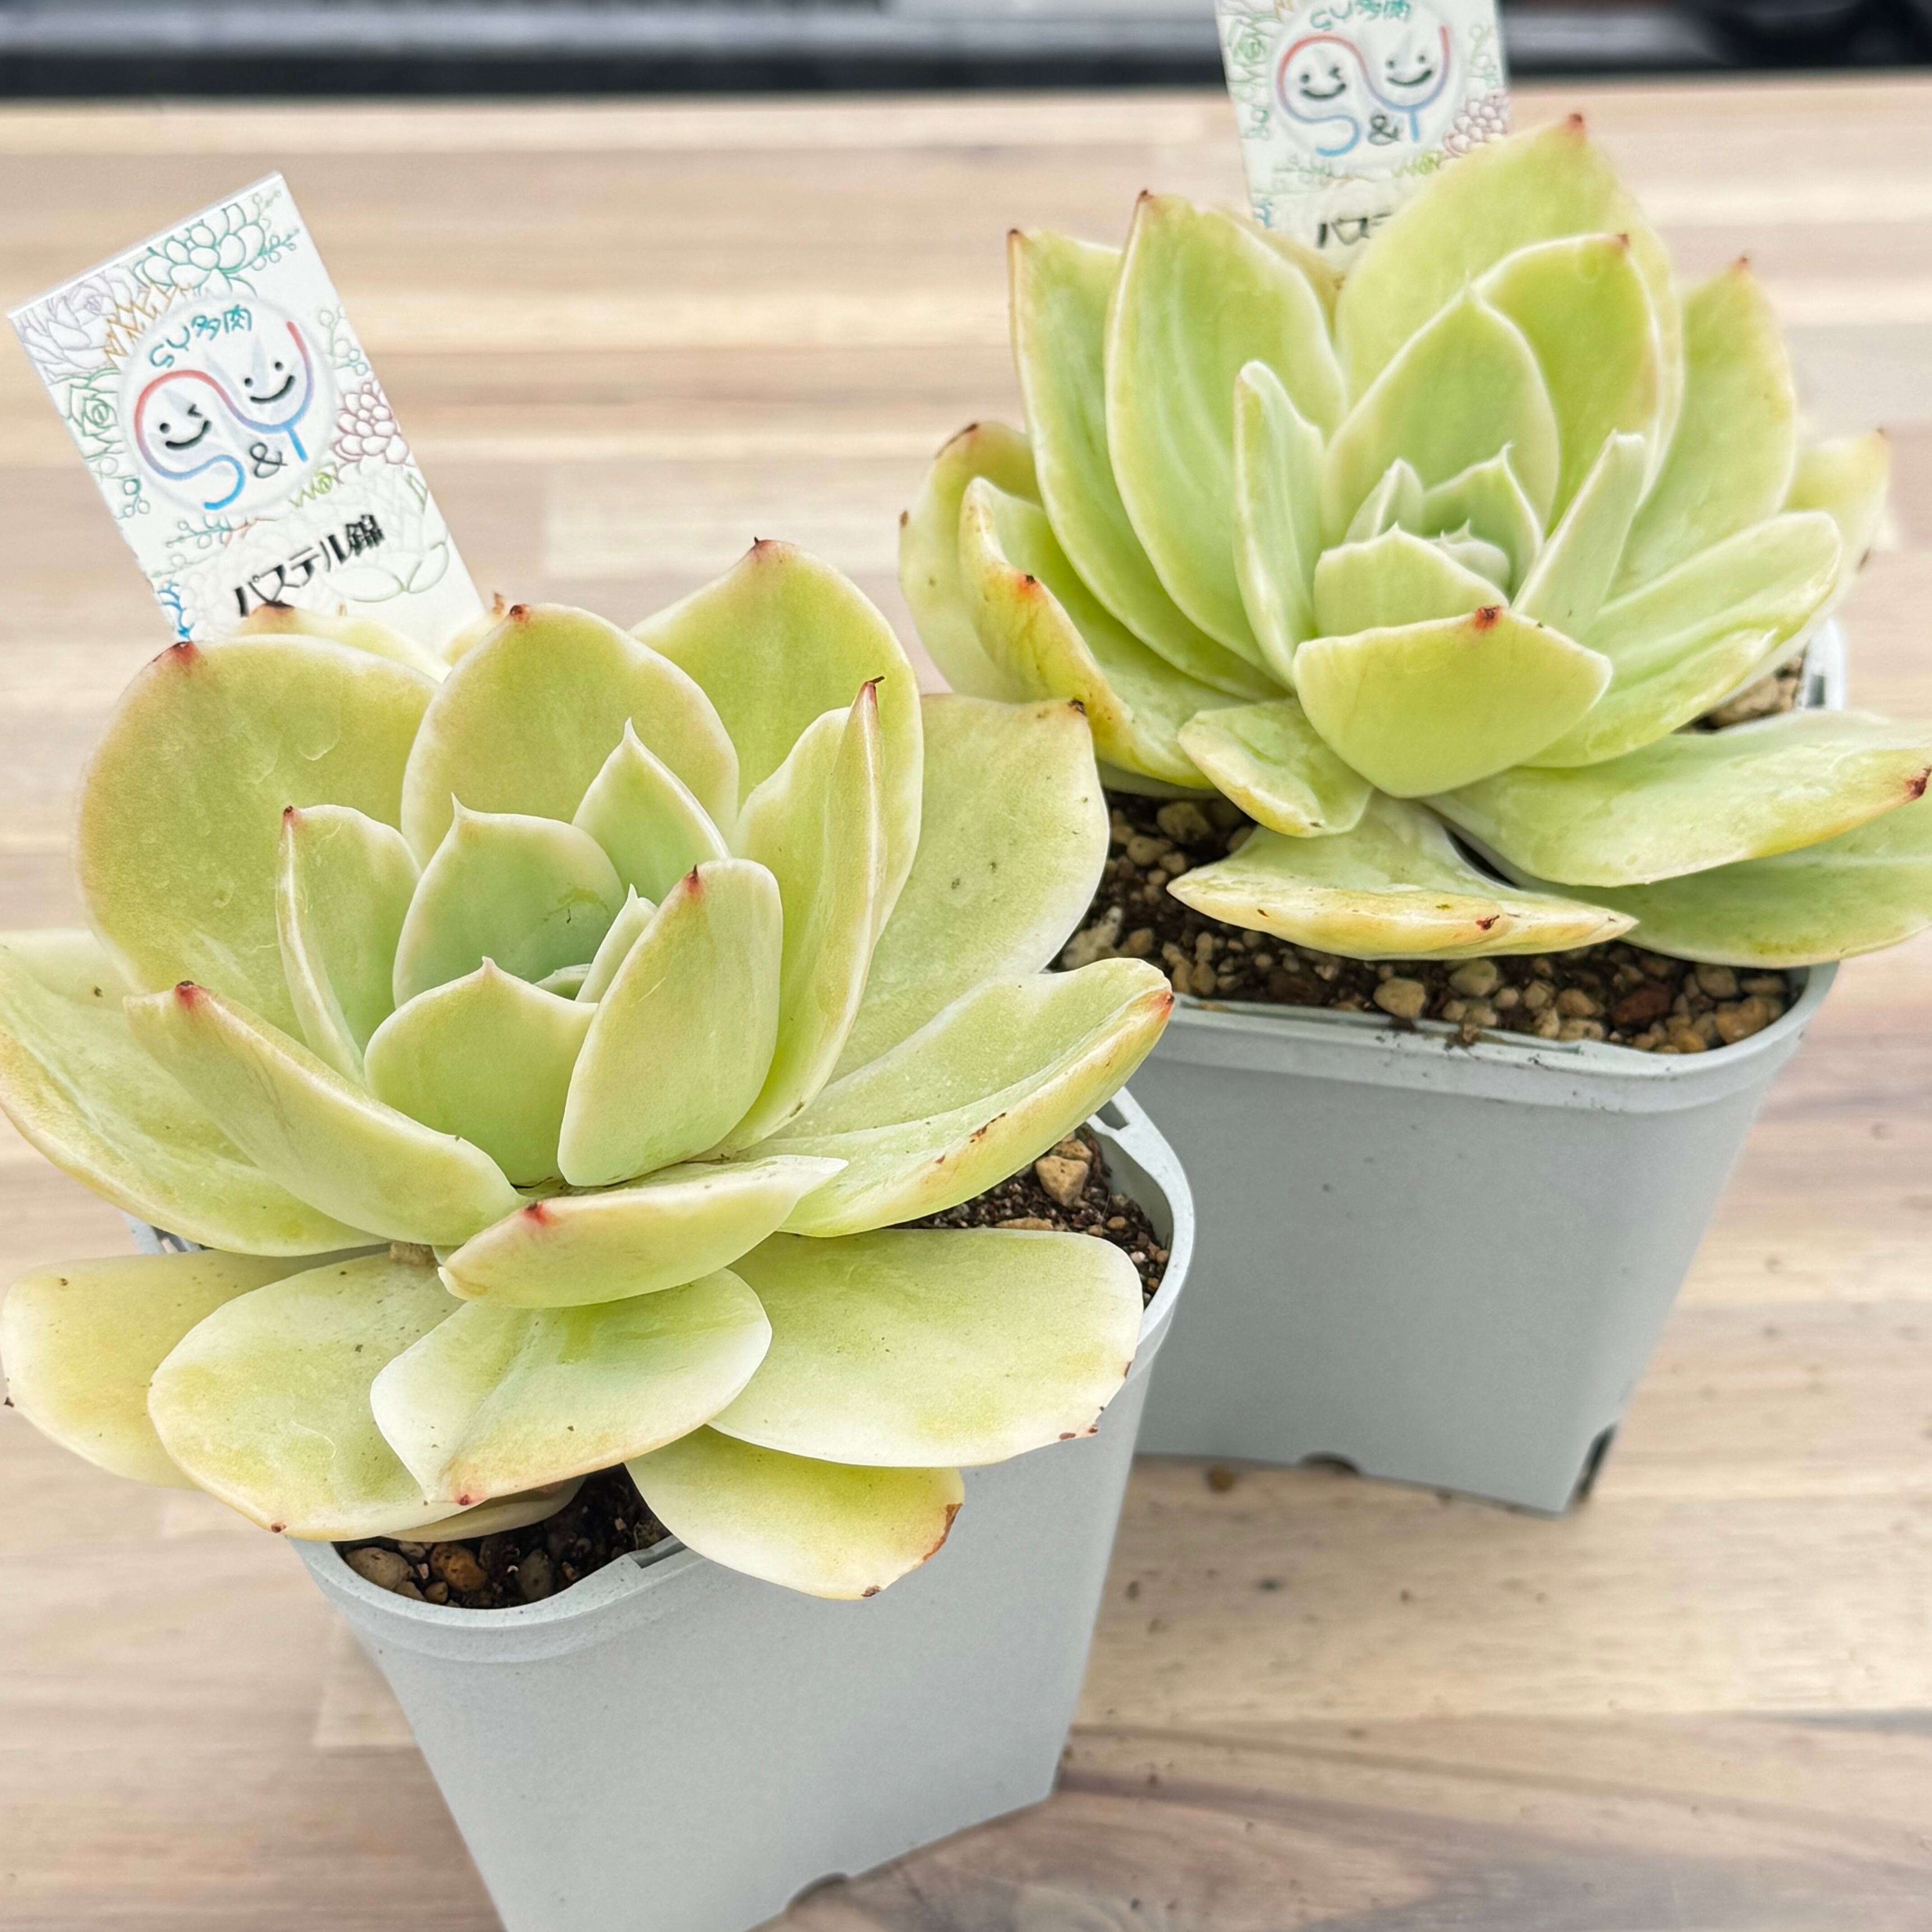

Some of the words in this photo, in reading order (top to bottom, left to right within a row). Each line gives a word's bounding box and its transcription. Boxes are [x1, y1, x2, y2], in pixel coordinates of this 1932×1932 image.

[234, 514, 385, 617] パステル錦
